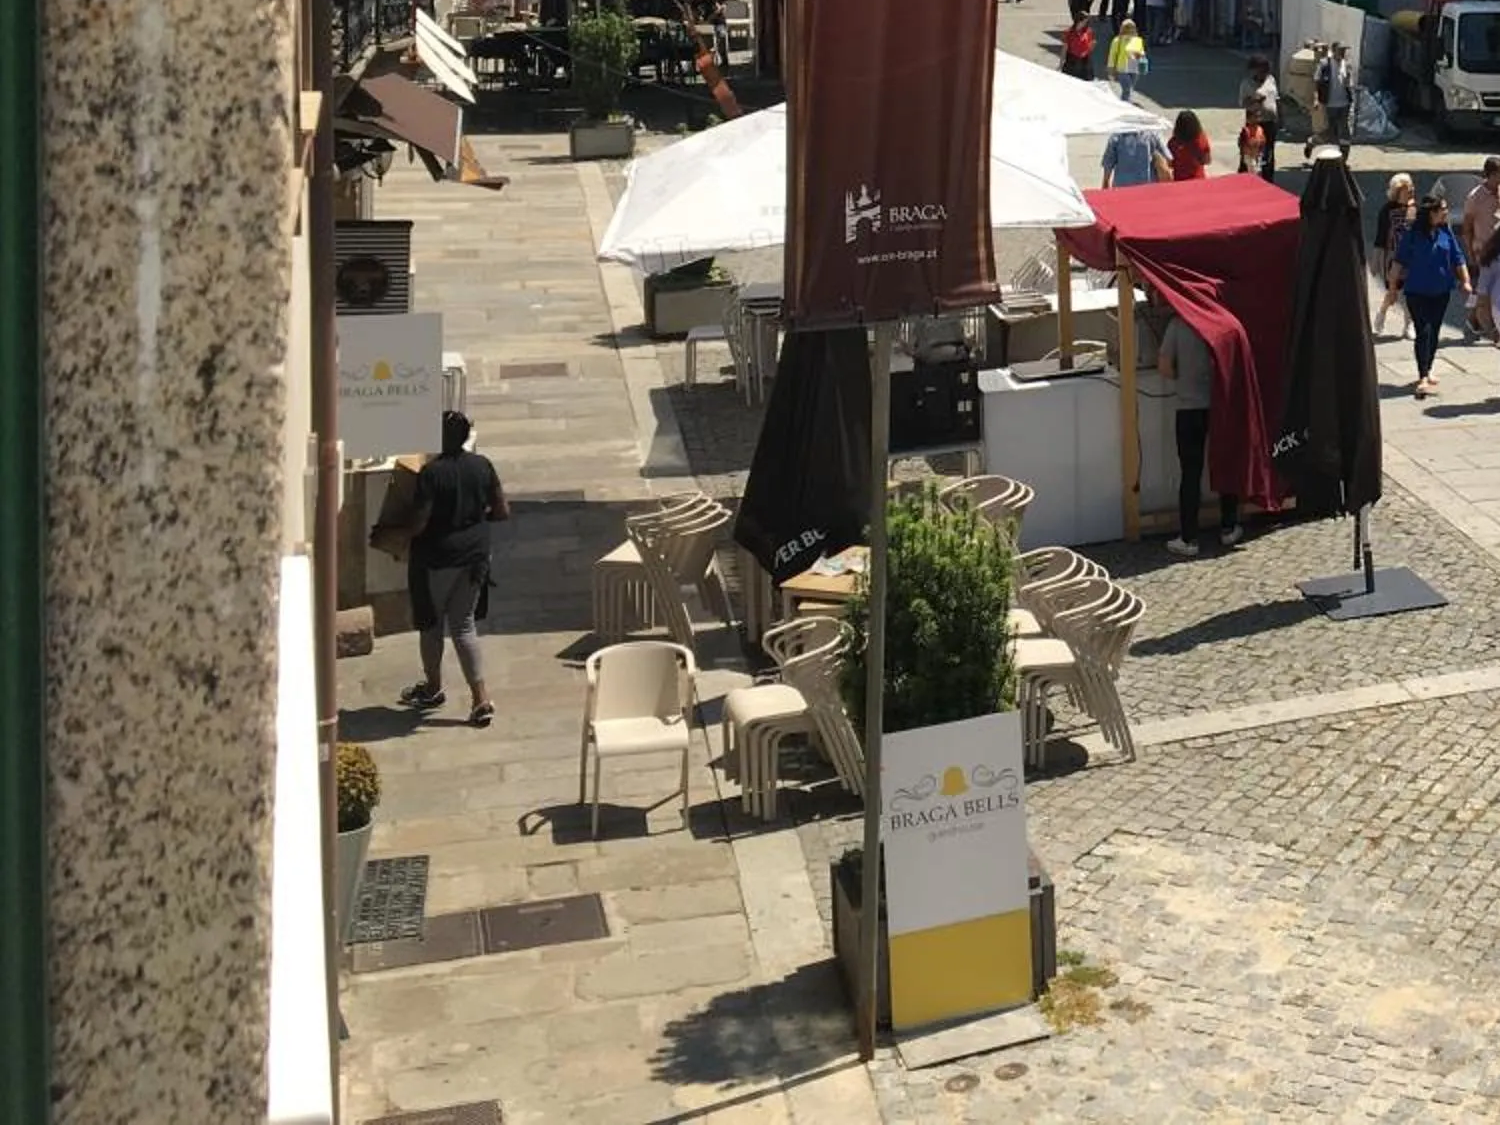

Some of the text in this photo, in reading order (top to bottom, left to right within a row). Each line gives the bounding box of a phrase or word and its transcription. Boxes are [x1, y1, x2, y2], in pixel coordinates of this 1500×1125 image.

[889, 204, 948, 224] BRAGA
[889, 792, 1020, 832] BRAGA BELLS
